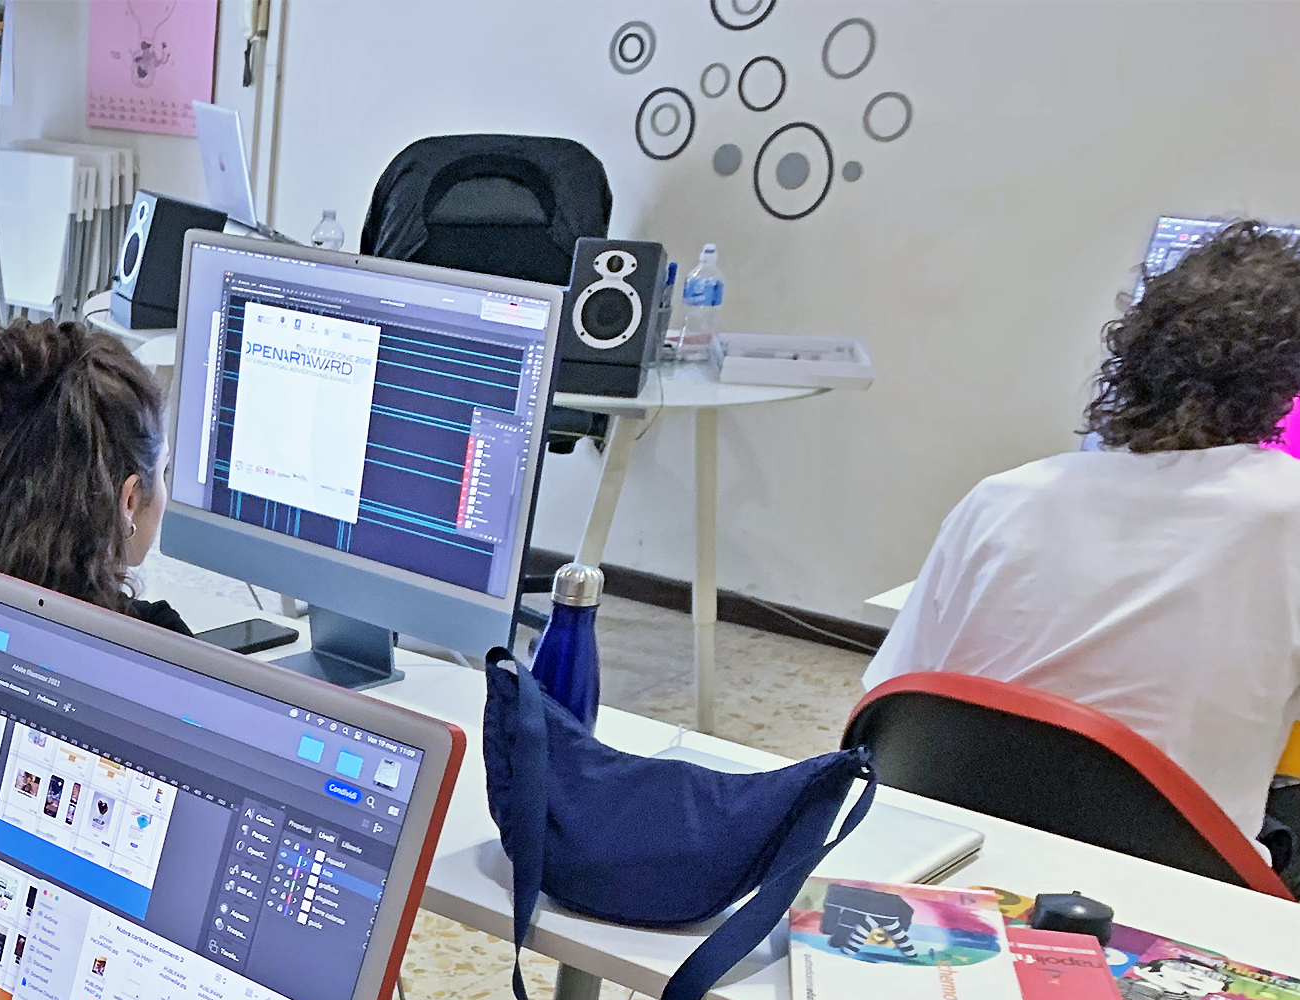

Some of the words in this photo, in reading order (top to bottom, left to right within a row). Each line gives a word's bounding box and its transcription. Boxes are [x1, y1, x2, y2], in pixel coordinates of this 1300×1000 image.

[327, 782, 358, 801] Condividi
[115, 924, 131, 937] Nuova
[129, 932, 149, 946] cartella
[148, 941, 159, 951] con
[157, 946, 180, 961] elementi
[26, 981, 44, 995] Creative
[42, 990, 54, 1000] Cloud
